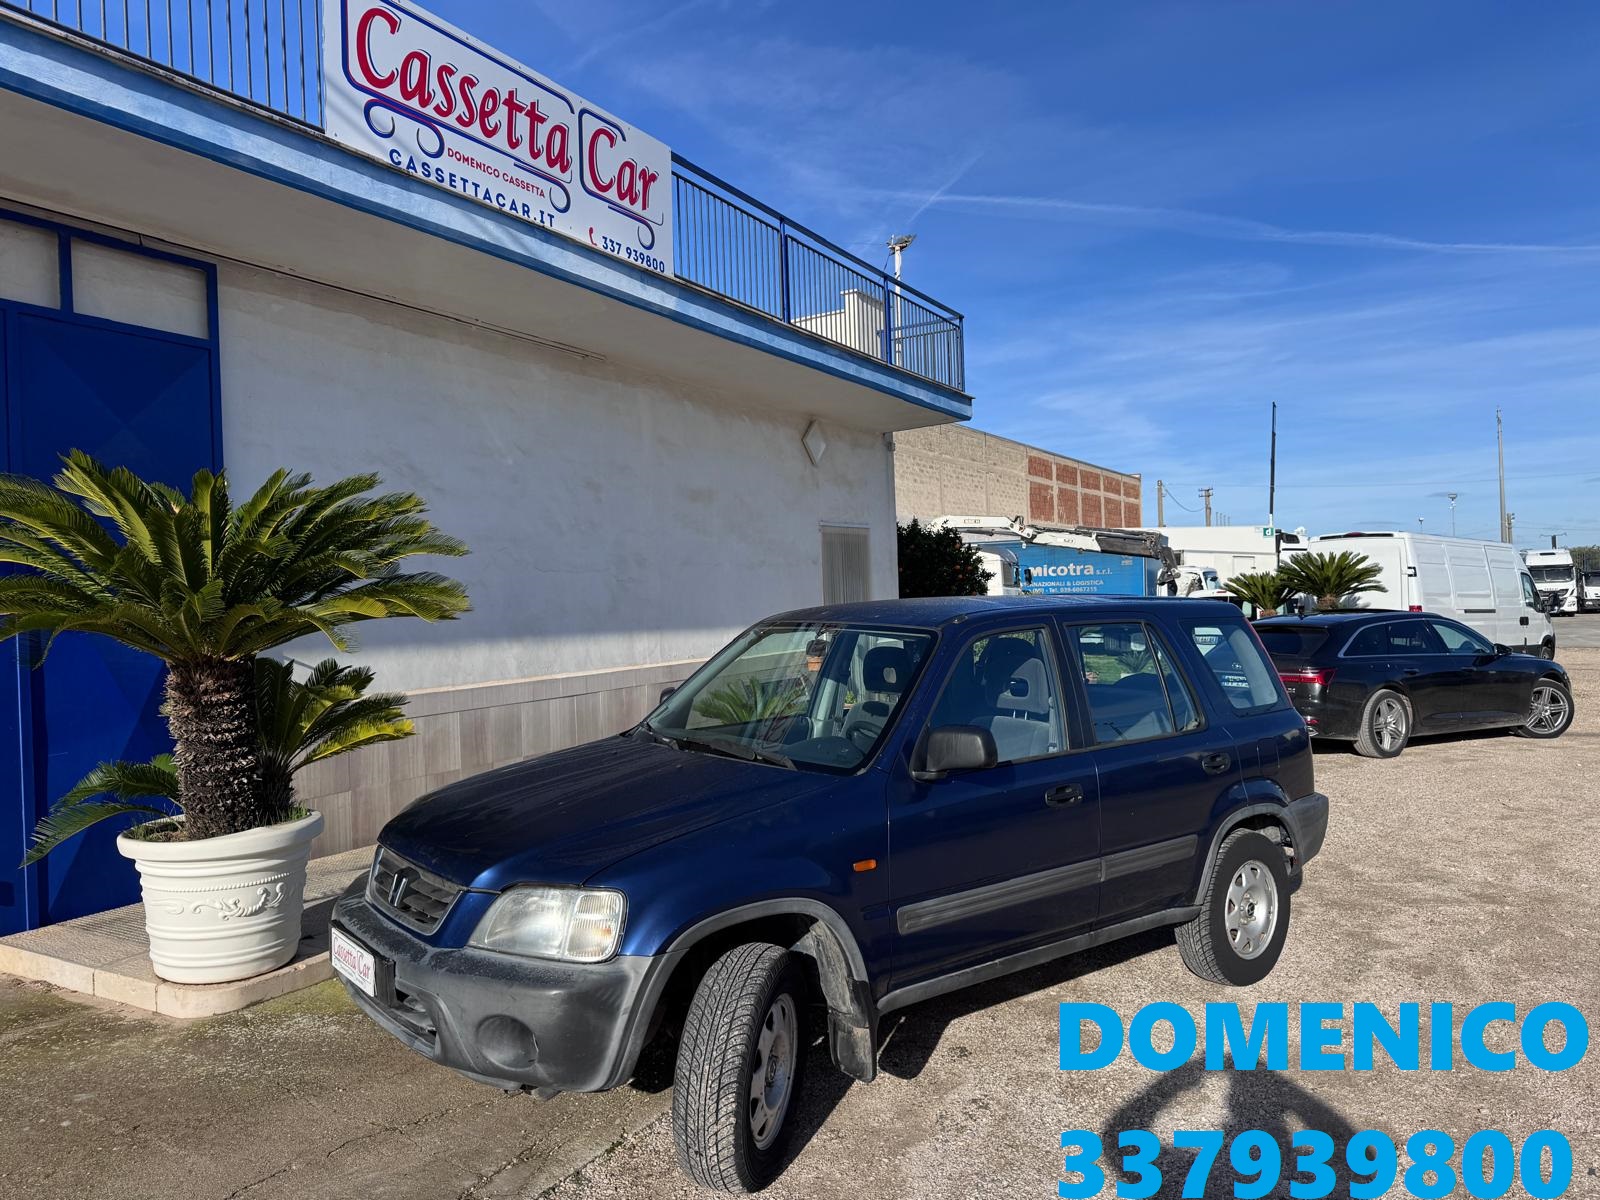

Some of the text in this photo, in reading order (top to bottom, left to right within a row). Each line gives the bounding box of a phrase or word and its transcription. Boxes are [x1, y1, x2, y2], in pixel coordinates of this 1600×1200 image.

[356, 7, 658, 211] Cassetta Car
[389, 149, 555, 228] CASSETTACAR.IT
[447, 147, 545, 198] DOMENICO CASSETTA
[602, 235, 665, 273] 337 939800
[358, 953, 371, 979] Car
